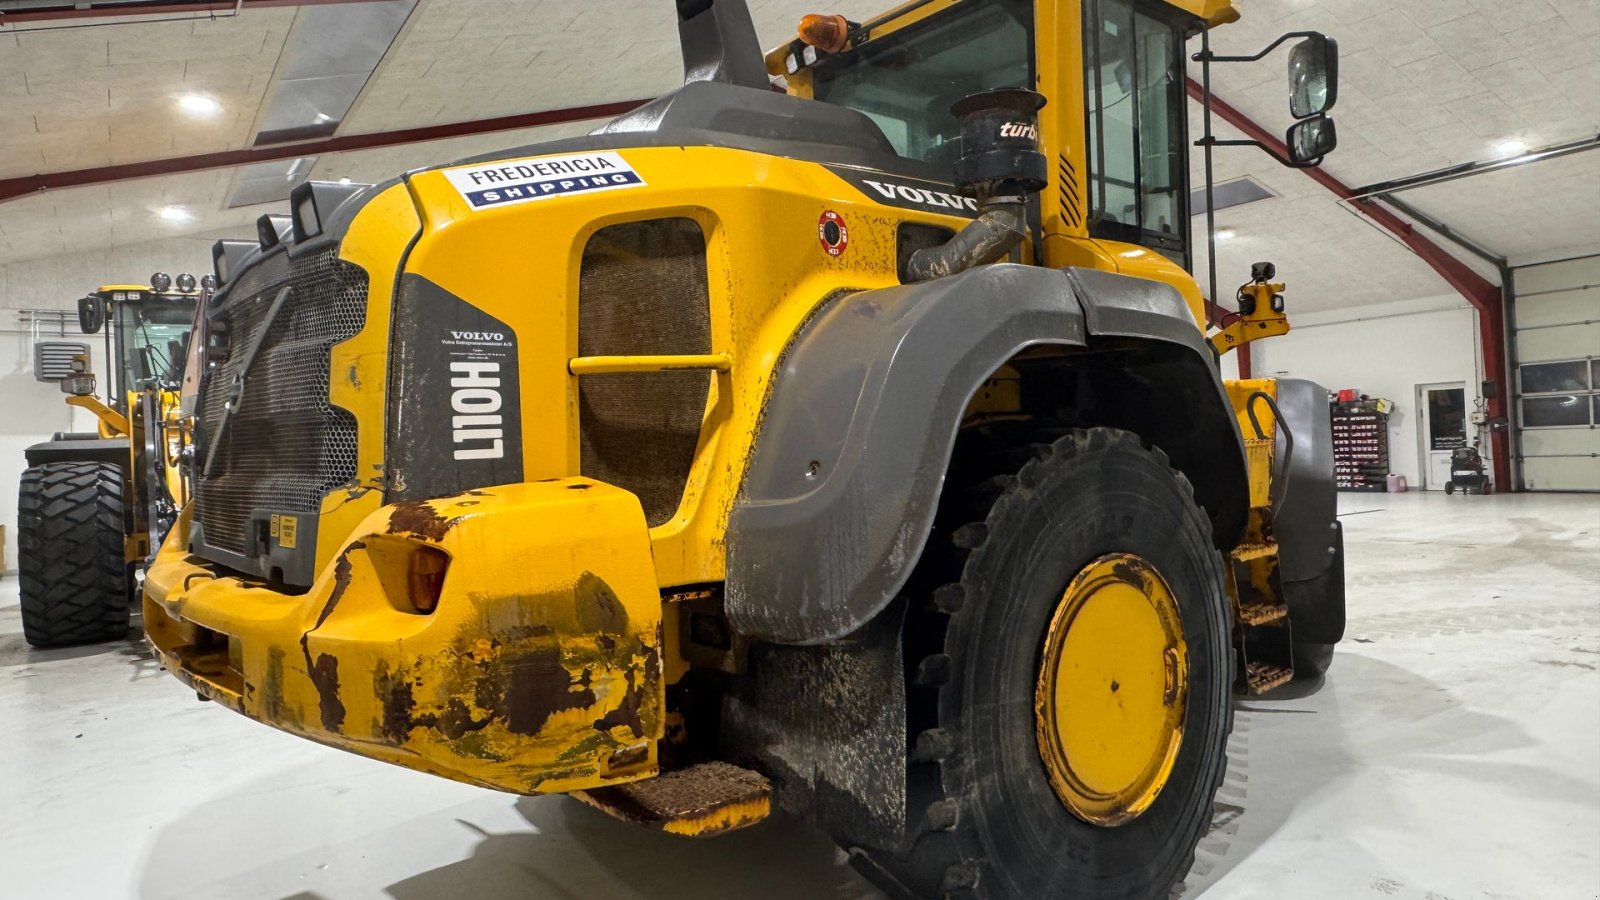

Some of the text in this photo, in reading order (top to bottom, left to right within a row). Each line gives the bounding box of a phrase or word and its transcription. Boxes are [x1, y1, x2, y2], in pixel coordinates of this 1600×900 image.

[1000, 121, 1038, 142] turb
[468, 156, 615, 185] FREDERICIA
[482, 174, 629, 202] SHIPPING
[450, 331, 504, 341] VOLVO
[449, 362, 504, 460] L110H
